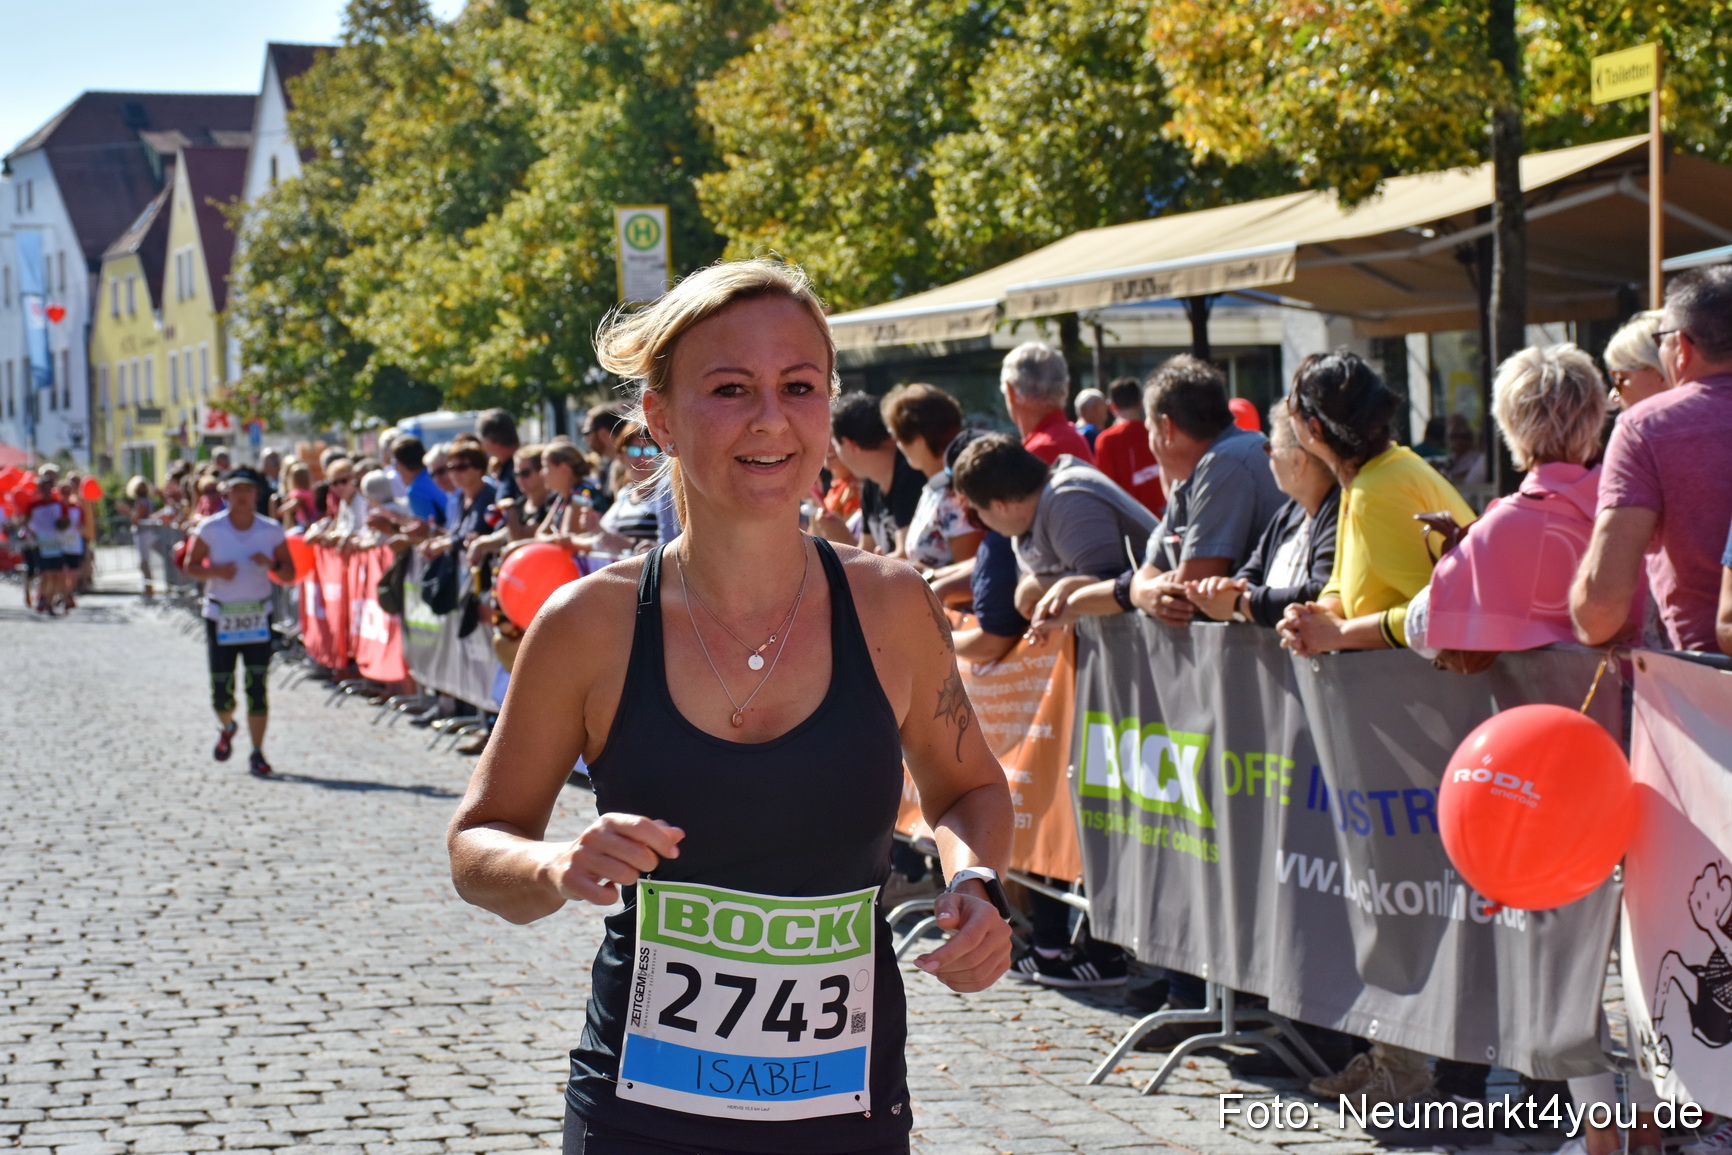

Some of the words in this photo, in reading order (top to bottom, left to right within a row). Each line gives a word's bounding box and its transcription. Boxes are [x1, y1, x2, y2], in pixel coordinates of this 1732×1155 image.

[1605, 63, 1653, 87] Toiletten
[1453, 753, 1542, 801] RÖDL
[1490, 787, 1538, 809] energie
[663, 896, 863, 952] BOCK
[658, 961, 850, 1042] 2743
[696, 1054, 831, 1096] ISABEL
